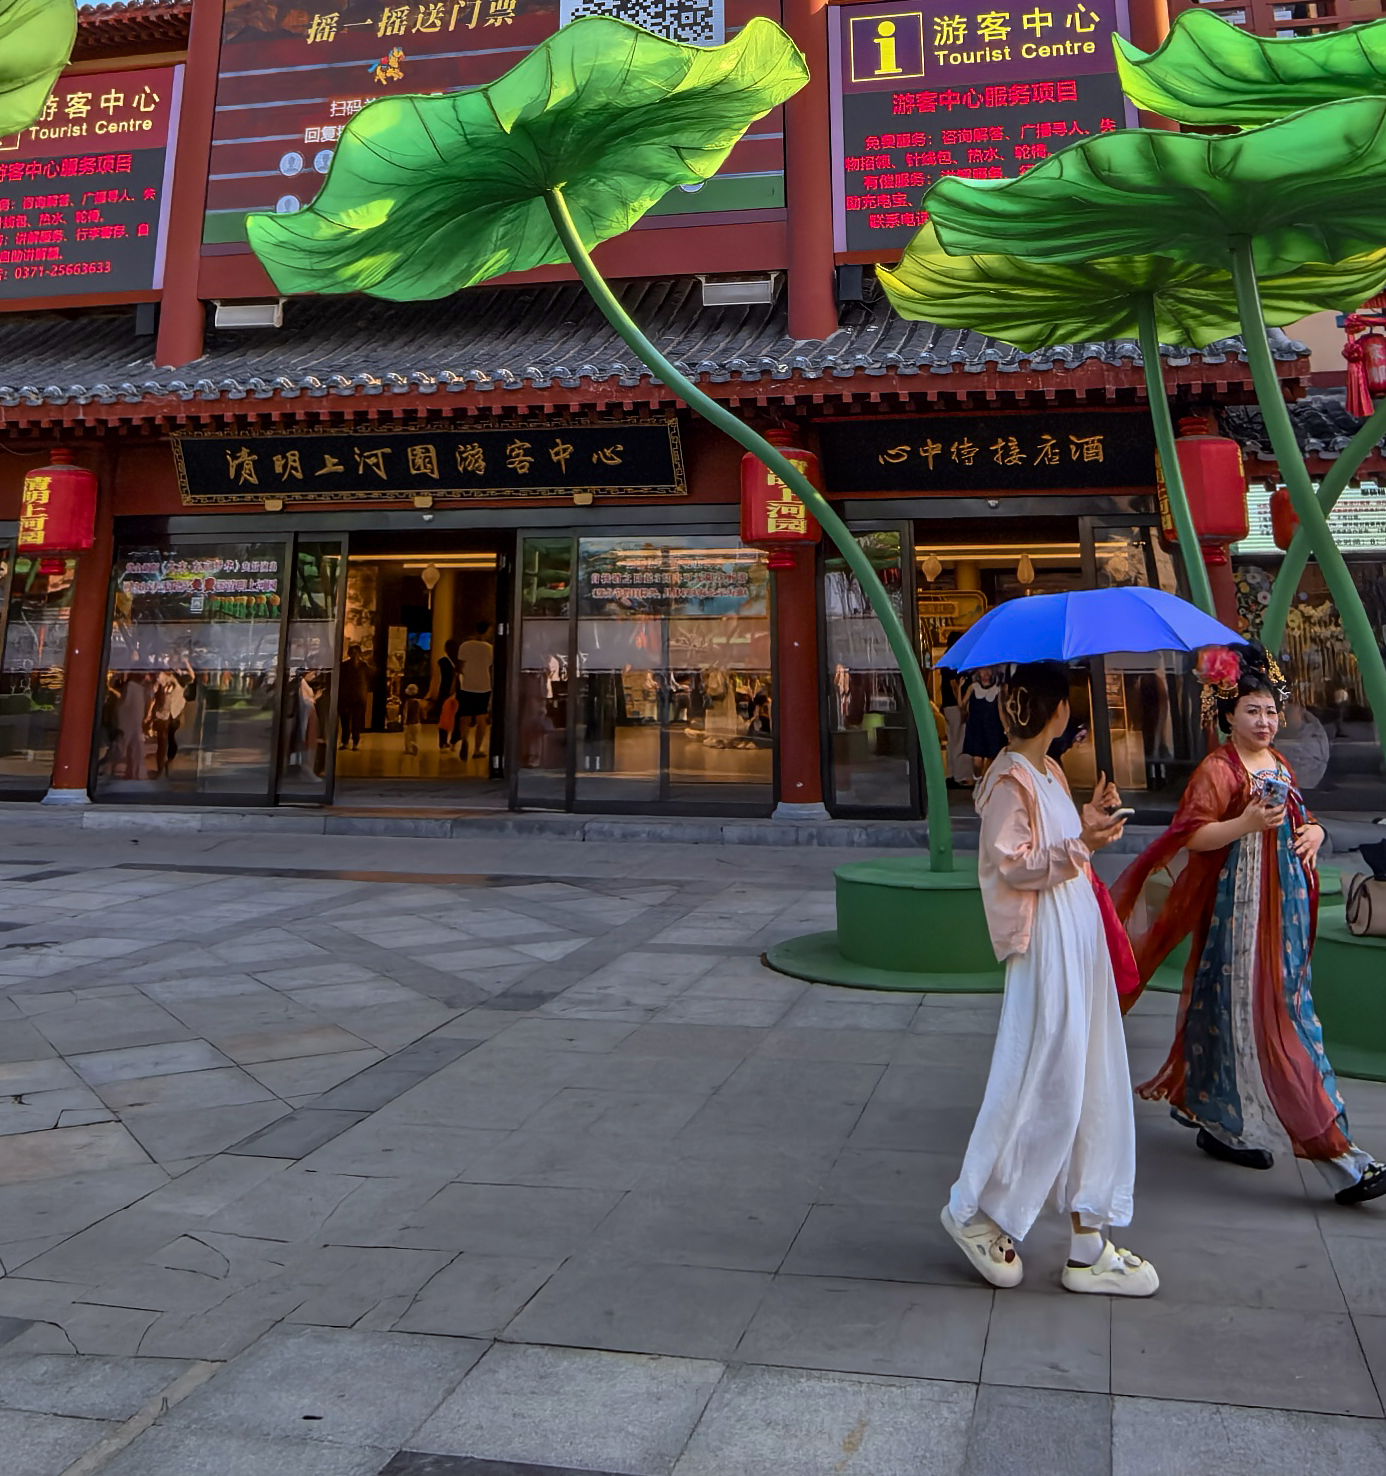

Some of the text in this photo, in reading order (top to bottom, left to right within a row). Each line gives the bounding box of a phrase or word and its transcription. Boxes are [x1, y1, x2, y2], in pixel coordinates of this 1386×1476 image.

[933, 3, 1100, 46] 游客中心
[935, 39, 1096, 66] Tourist Centre
[330, 97, 377, 117] 扫码
[892, 80, 1077, 115] 游客中心服务项目
[29, 118, 153, 141] Tourist Centre
